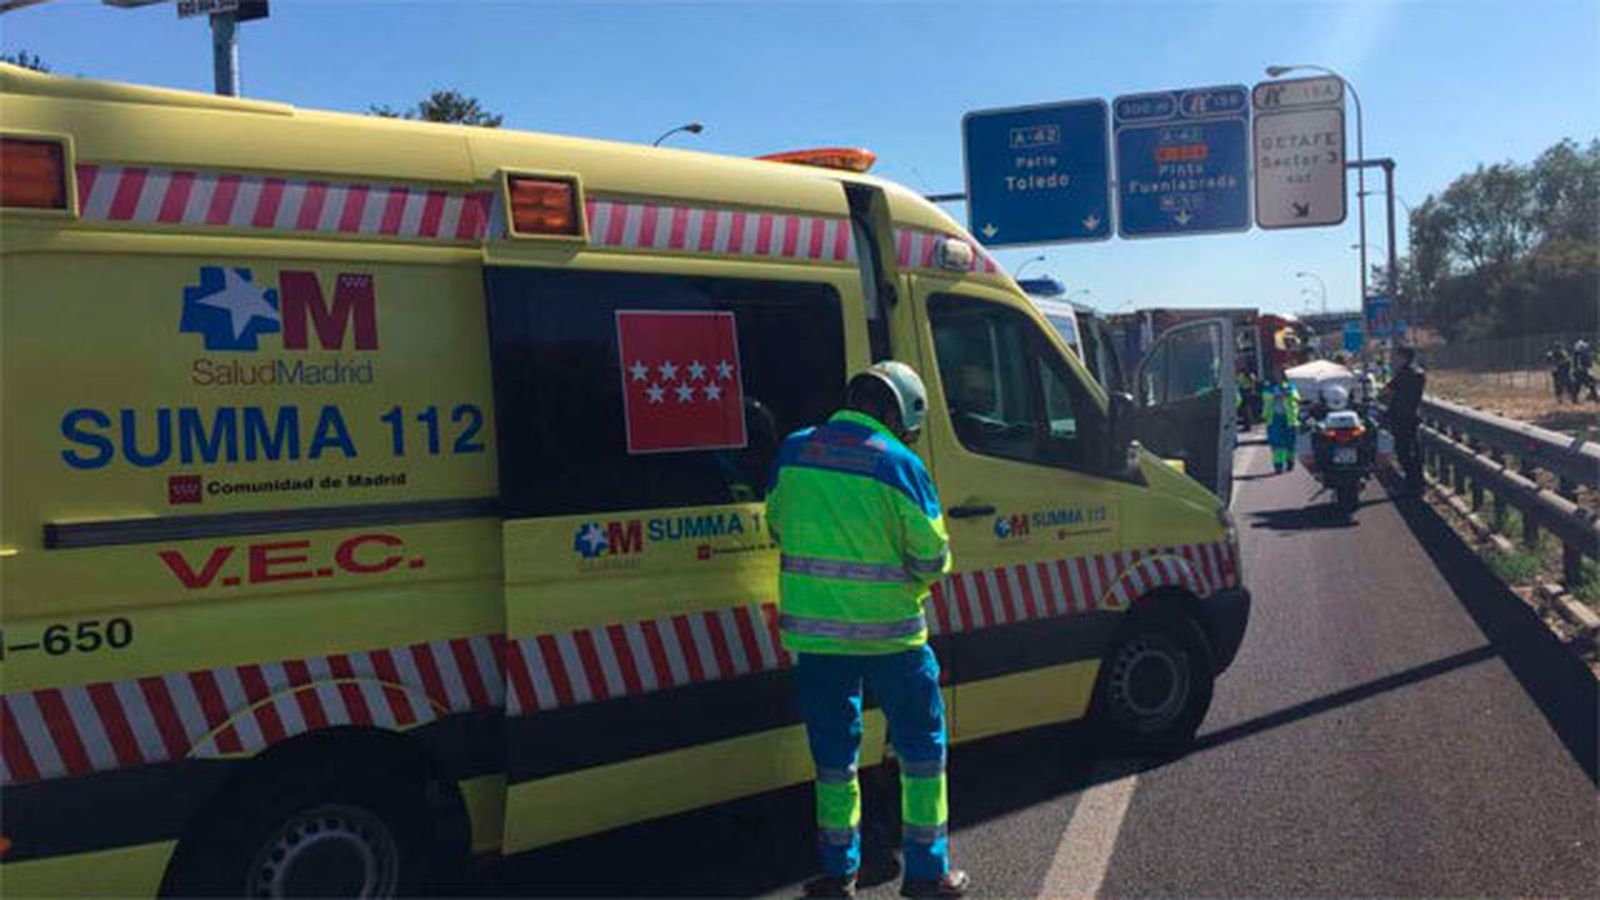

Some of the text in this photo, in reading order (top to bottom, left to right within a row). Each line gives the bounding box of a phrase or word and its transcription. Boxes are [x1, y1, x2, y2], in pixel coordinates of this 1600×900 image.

[1013, 129, 1057, 144] A-42
[1005, 172, 1070, 192] Toledo
[279, 271, 378, 350] M
[191, 359, 374, 387] SaludMadrid
[60, 404, 486, 470] SUMMA 112
[207, 472, 407, 495] Comunidad de Madrid
[648, 513, 745, 542] SUMMA
[1031, 509, 1084, 528] SUMMA
[159, 533, 425, 589] V.E.C.
[0, 617, 134, 661] -650
